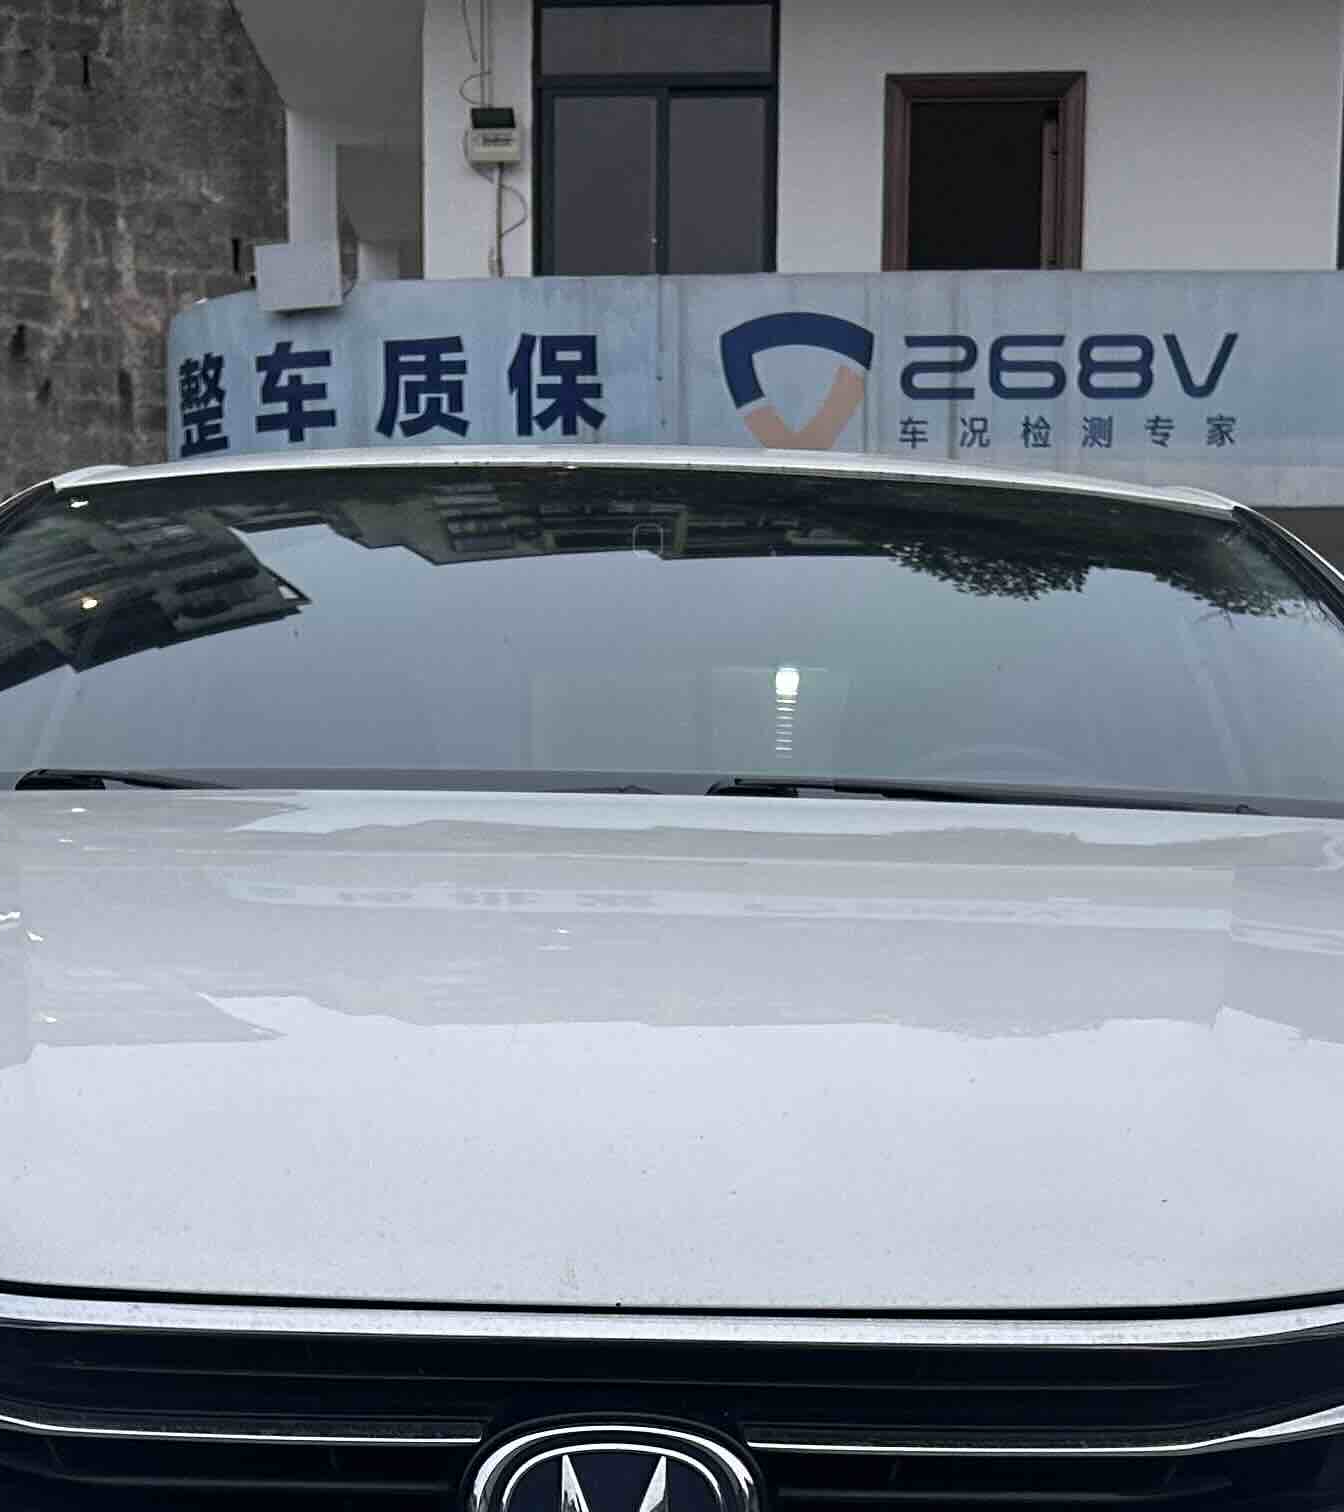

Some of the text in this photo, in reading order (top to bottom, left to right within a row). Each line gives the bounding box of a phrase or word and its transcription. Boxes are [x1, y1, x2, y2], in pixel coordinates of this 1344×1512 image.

[179, 333, 606, 457] 整车质保
[899, 332, 1239, 400] 268V
[898, 415, 1238, 449] 车况检测专家
